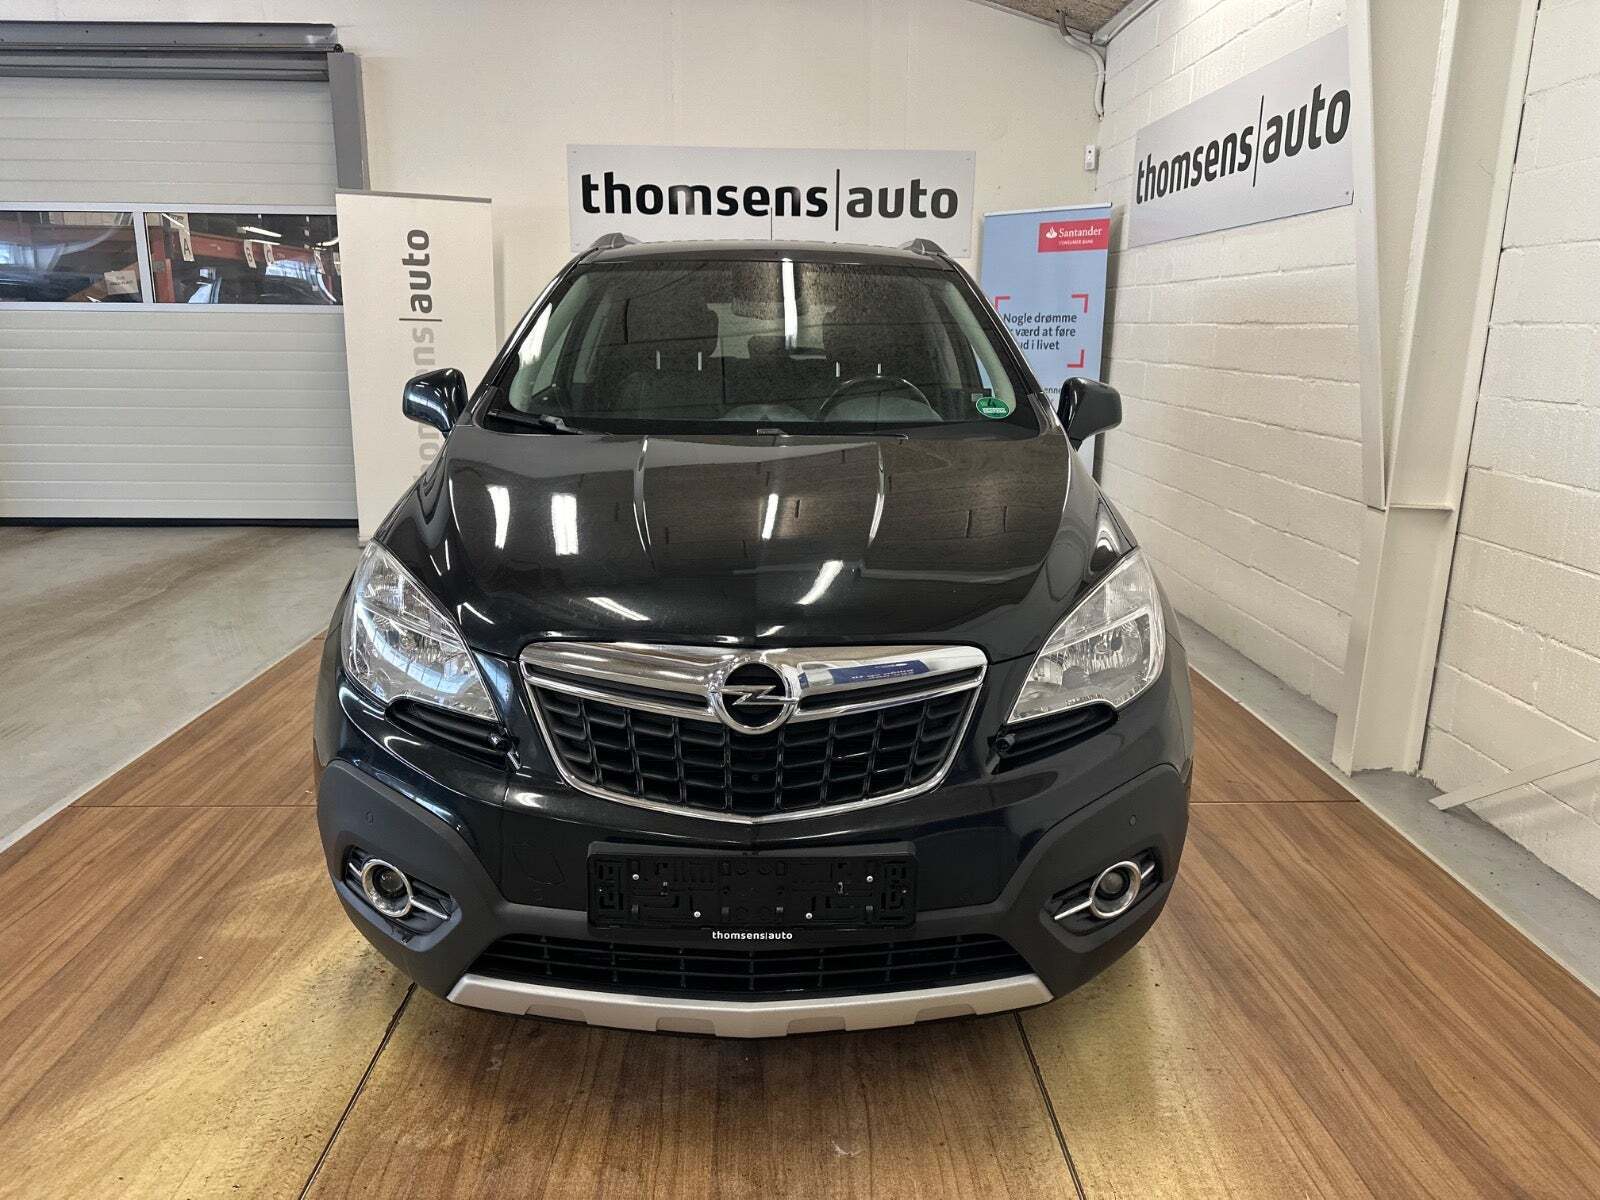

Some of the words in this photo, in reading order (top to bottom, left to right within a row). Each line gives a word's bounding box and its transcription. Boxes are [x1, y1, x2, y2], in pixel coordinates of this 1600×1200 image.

[1058, 225, 1103, 238] Santander
[1003, 312, 1032, 325] Nogle
[1035, 312, 1077, 323] drømme
[1015, 326, 1040, 337] værd
[1042, 327, 1053, 337] at
[1055, 326, 1076, 337] føre
[1036, 340, 1060, 350] livet
